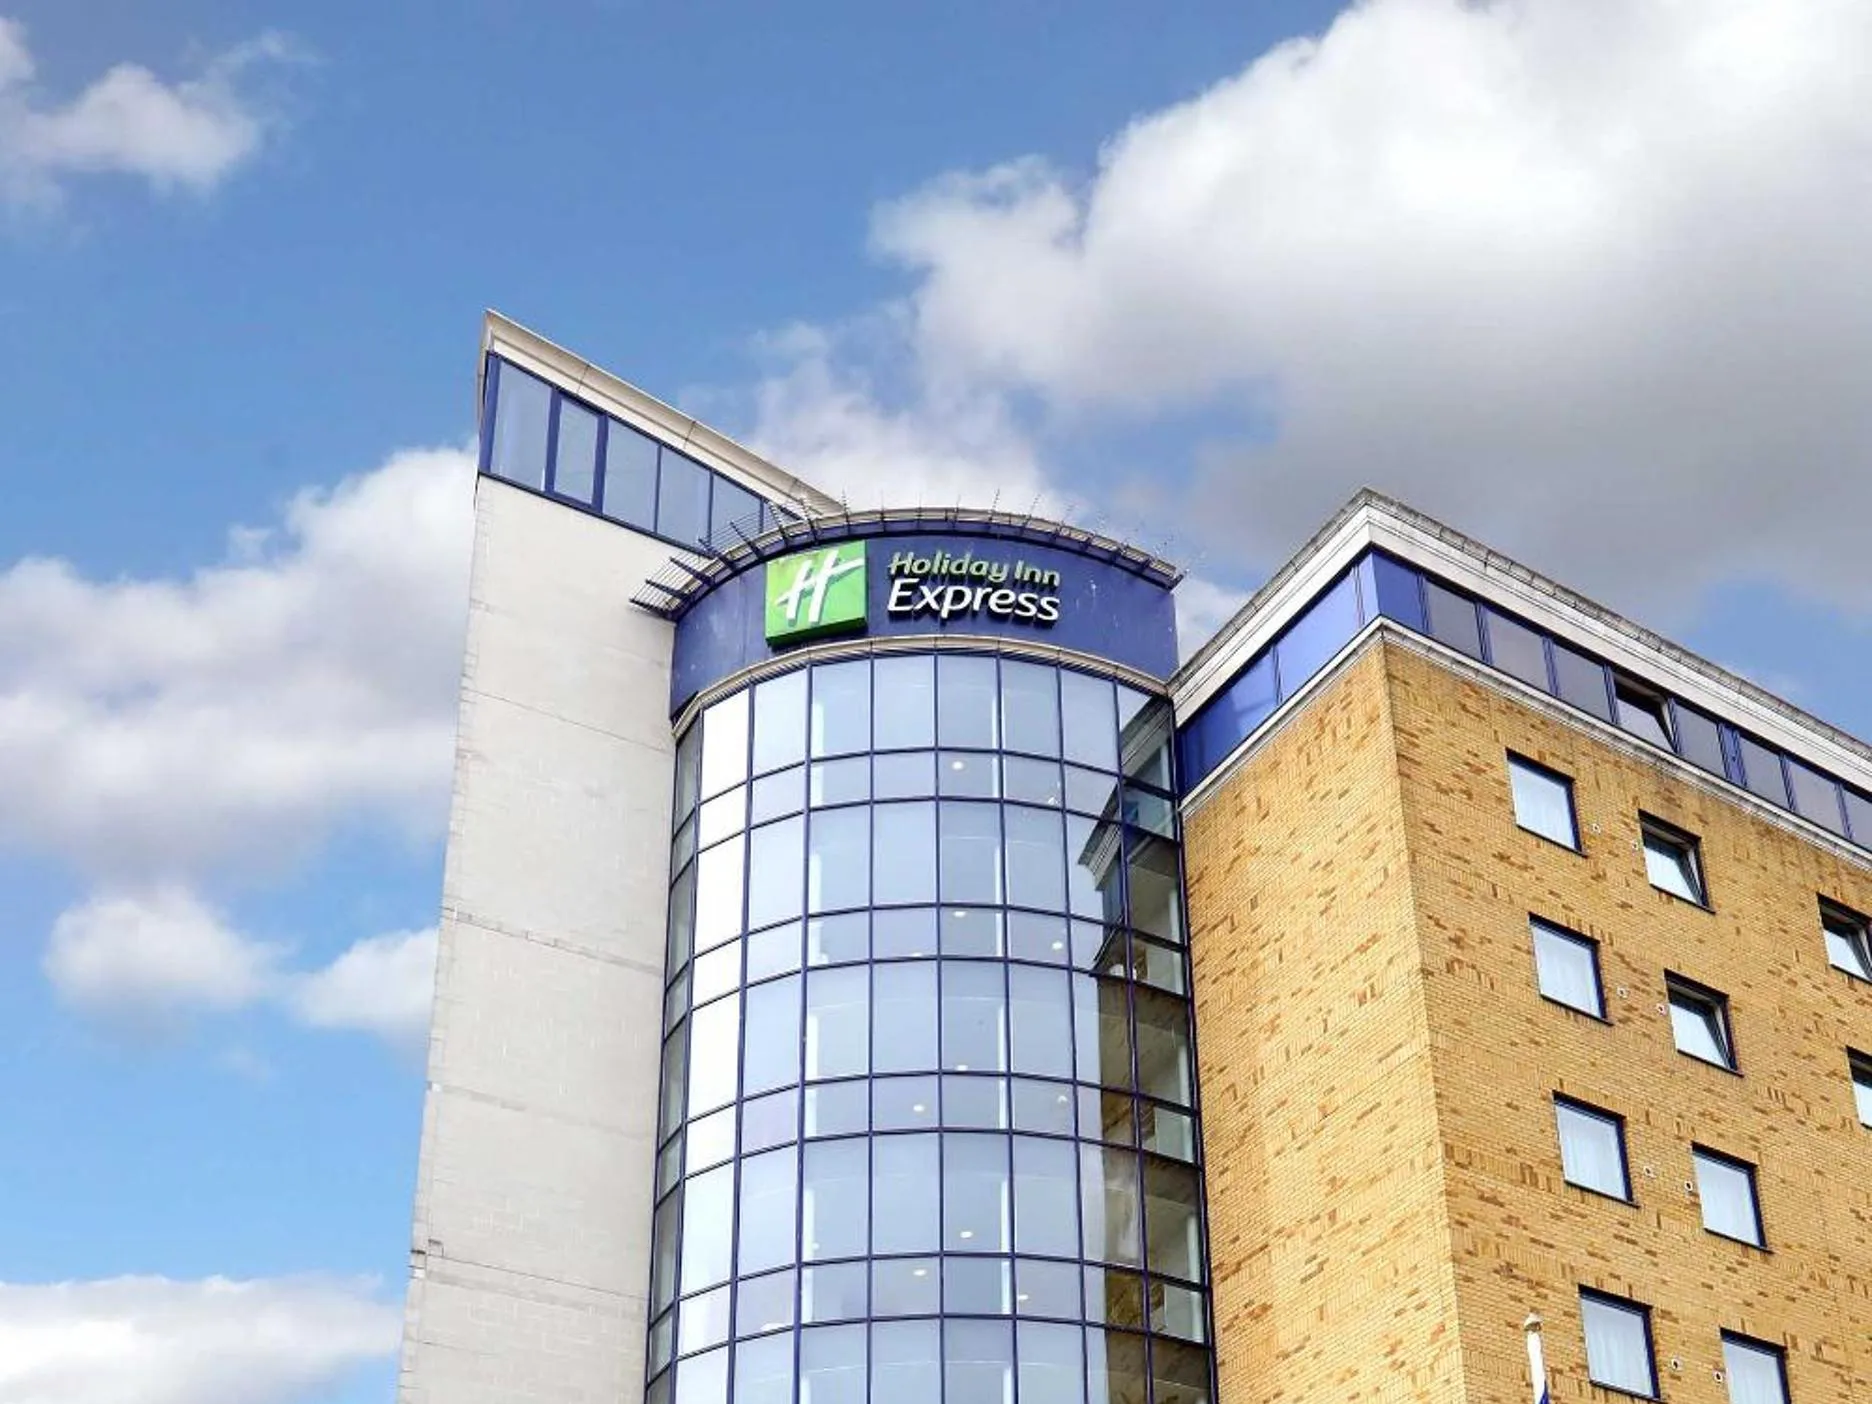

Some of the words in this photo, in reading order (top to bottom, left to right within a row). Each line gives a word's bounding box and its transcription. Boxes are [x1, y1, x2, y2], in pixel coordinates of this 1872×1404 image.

[888, 550, 1008, 583] Holiday
[1014, 558, 1061, 587] Inn
[887, 577, 1061, 622] Express
